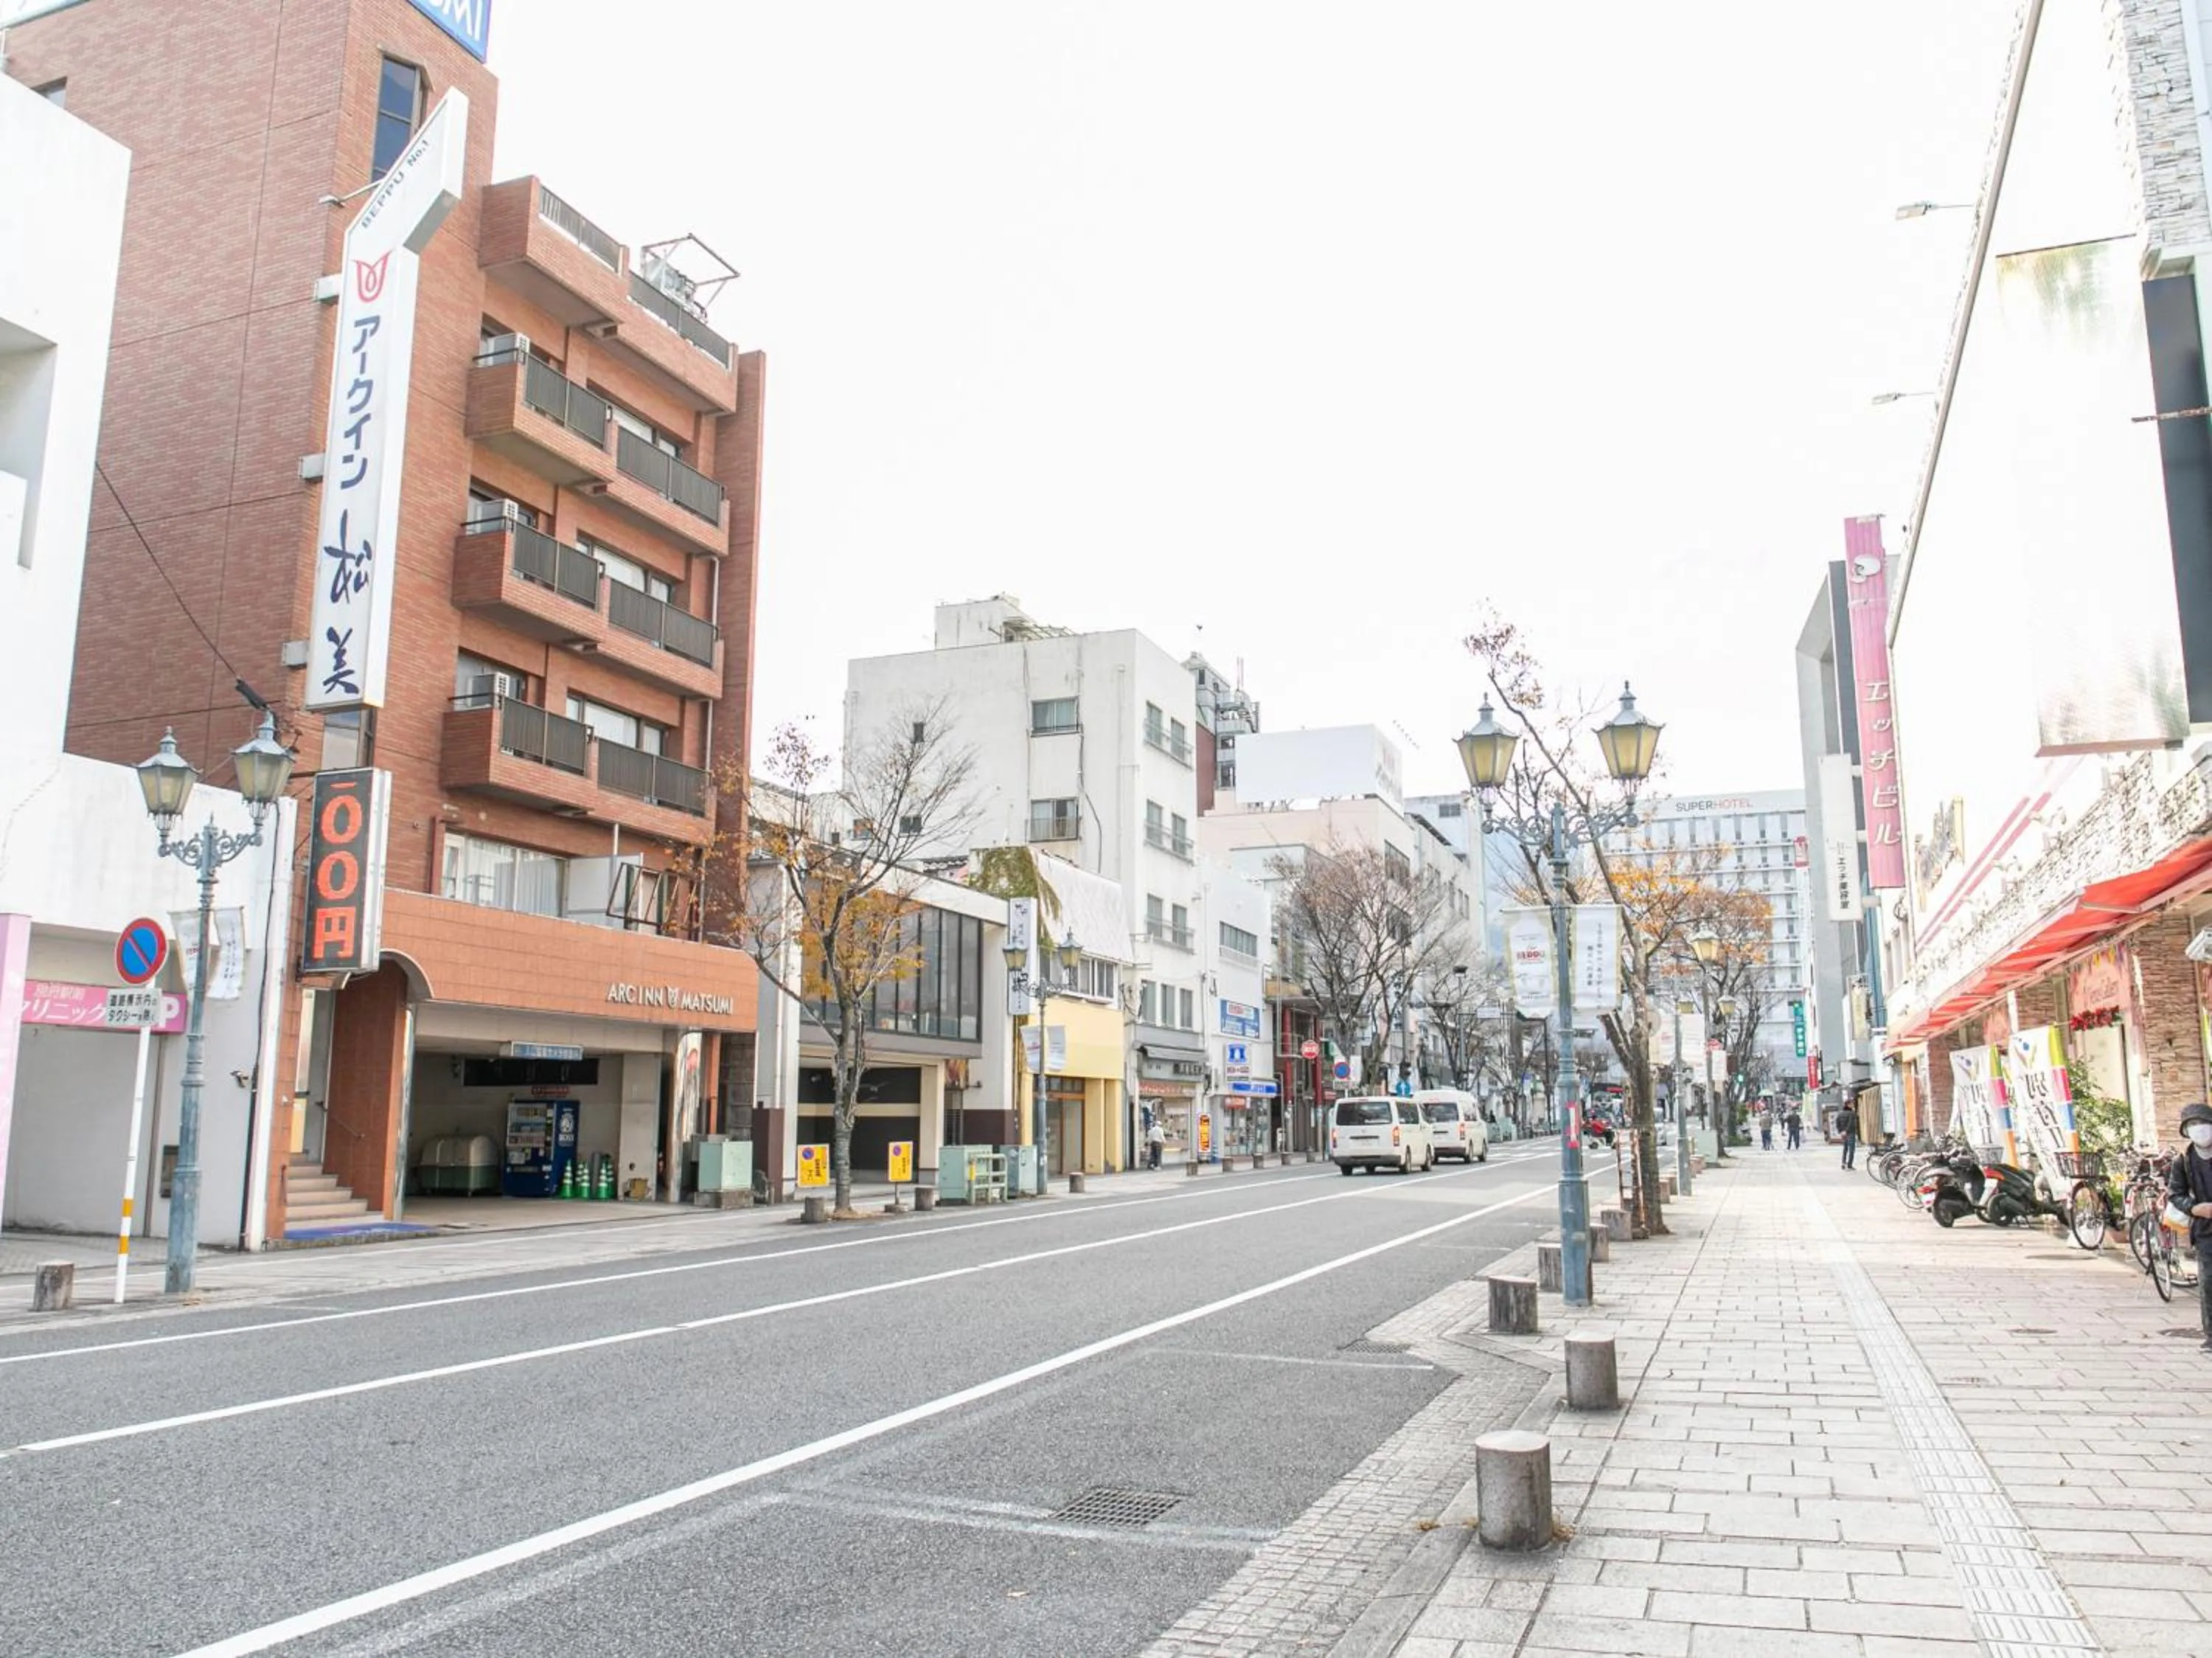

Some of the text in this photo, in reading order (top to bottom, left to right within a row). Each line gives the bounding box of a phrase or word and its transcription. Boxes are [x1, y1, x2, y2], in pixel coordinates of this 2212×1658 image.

[361, 139, 430, 229] BEPPU No.1
[340, 315, 380, 490] アークイン
[1864, 681, 1902, 845] エッチビル
[607, 982, 735, 1016] ARC INN MATSUMI
